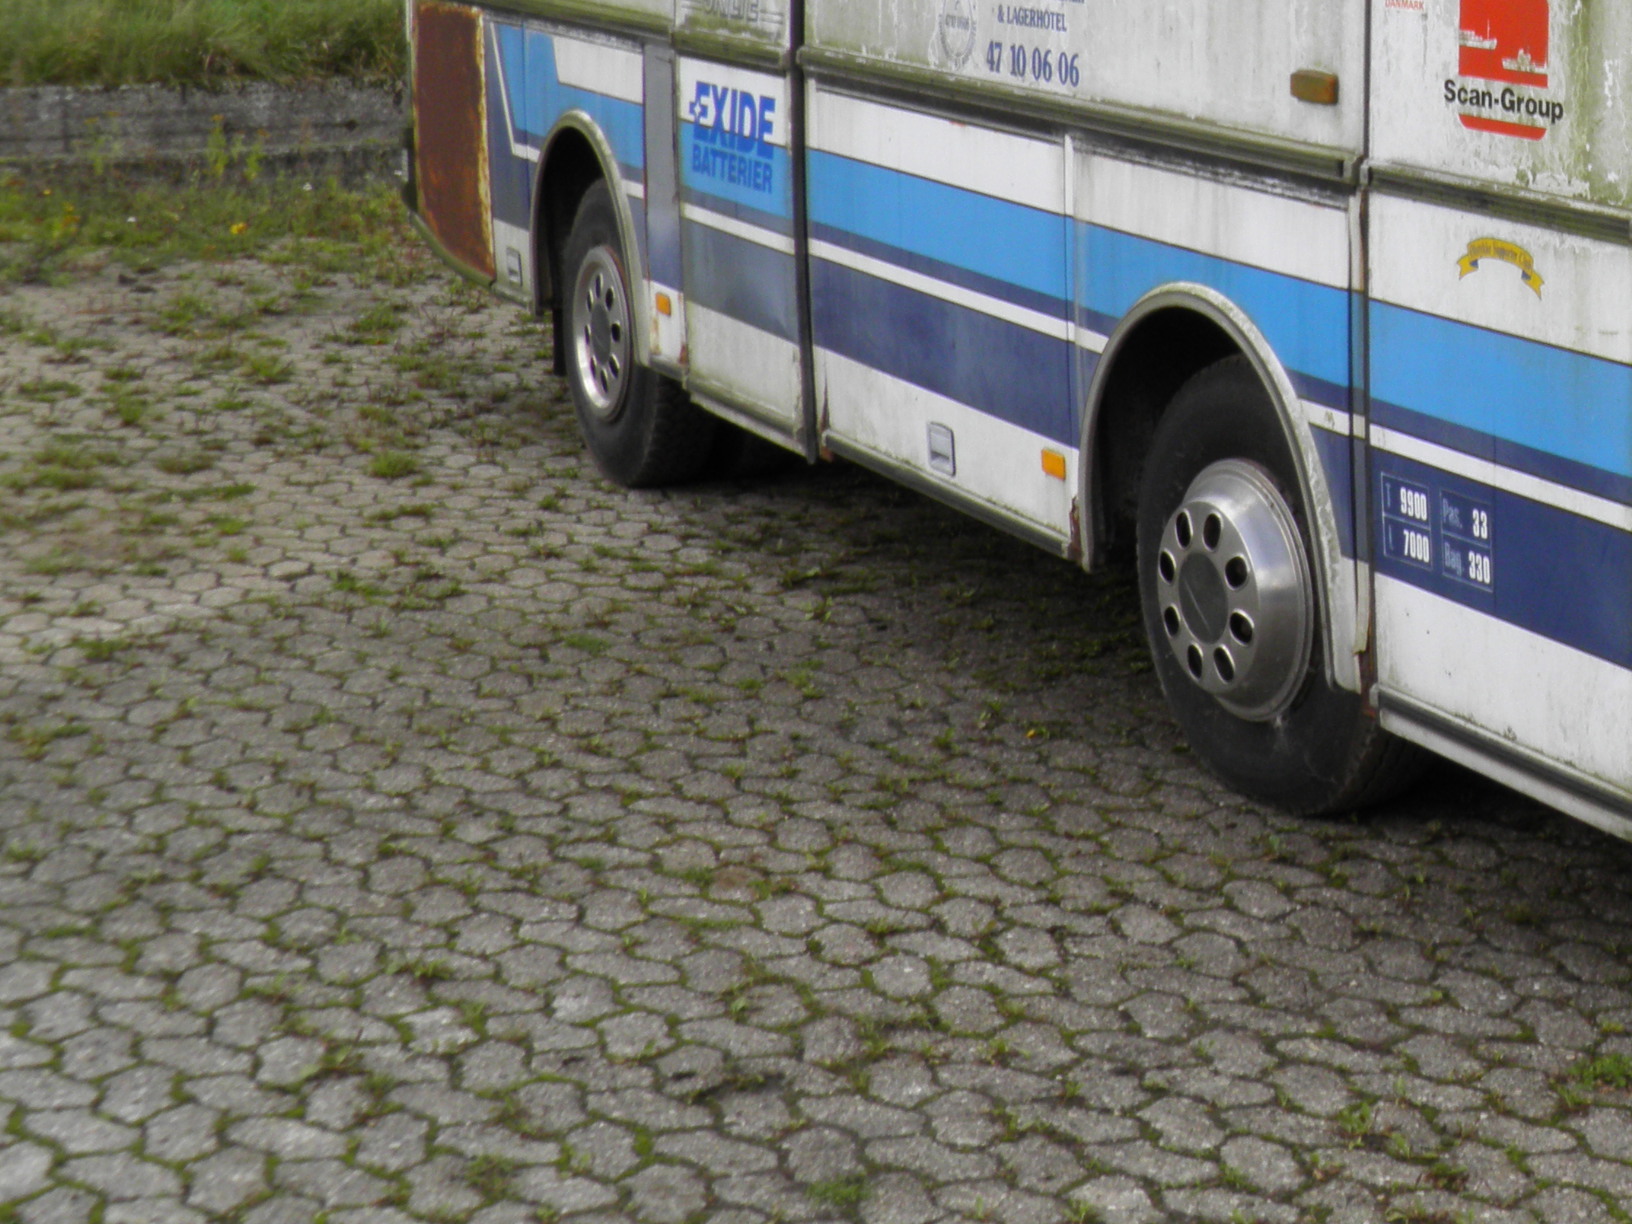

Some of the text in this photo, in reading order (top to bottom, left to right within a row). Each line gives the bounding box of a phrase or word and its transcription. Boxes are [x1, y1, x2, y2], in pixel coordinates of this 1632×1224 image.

[997, 4, 1004, 23] &
[1007, 5, 1068, 32] LAGERHOTEL
[986, 40, 1003, 74] 47
[1010, 43, 1026, 78] 10
[1032, 47, 1052, 83] 06
[1058, 51, 1080, 87] 06
[1443, 79, 1564, 124] Scan-Group
[690, 80, 776, 160] EXIDE
[691, 148, 773, 195] BATTERIER
[1400, 487, 1428, 522] 9900
[1472, 508, 1488, 540] 33
[1403, 529, 1430, 564] 7000
[1468, 551, 1491, 585] 330
